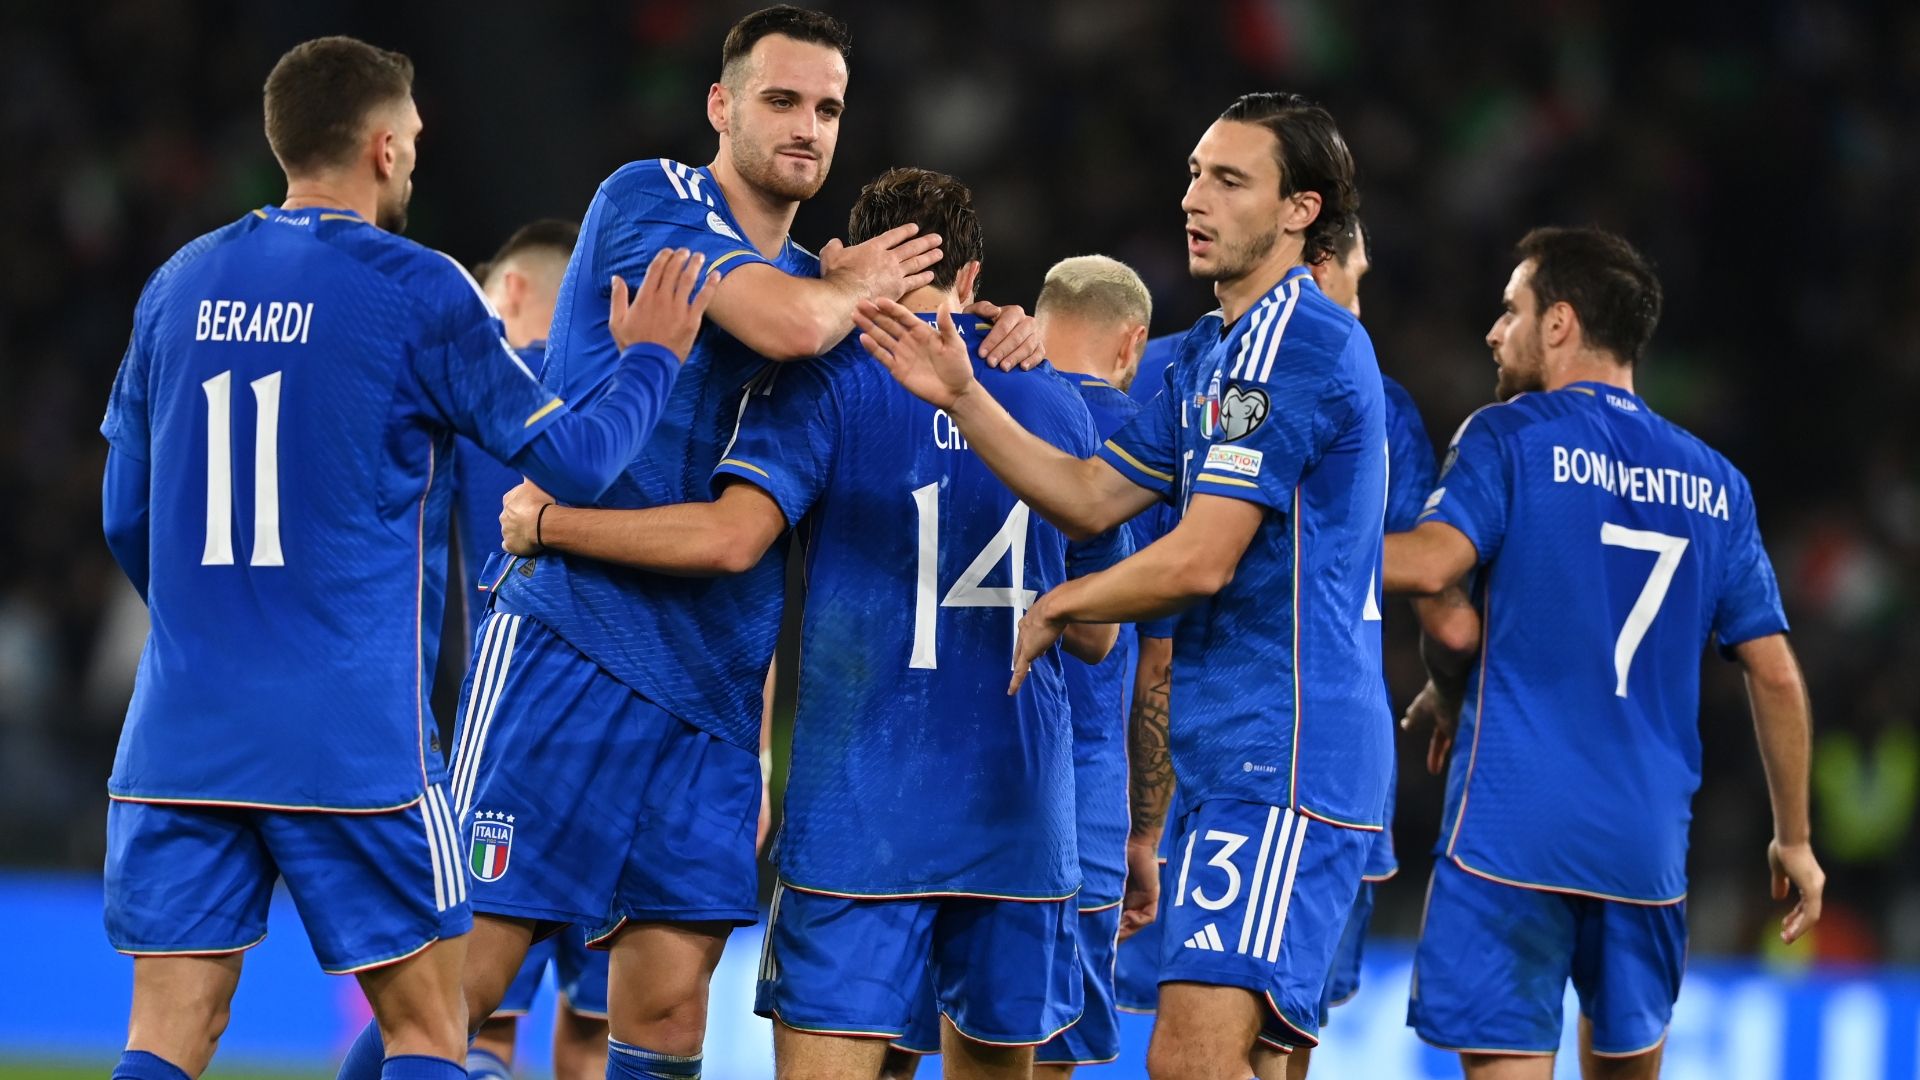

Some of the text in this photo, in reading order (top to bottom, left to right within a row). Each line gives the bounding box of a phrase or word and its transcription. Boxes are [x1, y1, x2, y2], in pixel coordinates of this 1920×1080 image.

[195, 299, 314, 344] BERARDI
[200, 369, 285, 567] 11
[1552, 445, 1729, 521] BONAVENTURA
[908, 481, 1039, 672] 14
[1600, 521, 1690, 698] 7
[475, 825, 509, 841] ITALIA
[1174, 829, 1250, 911] 13
